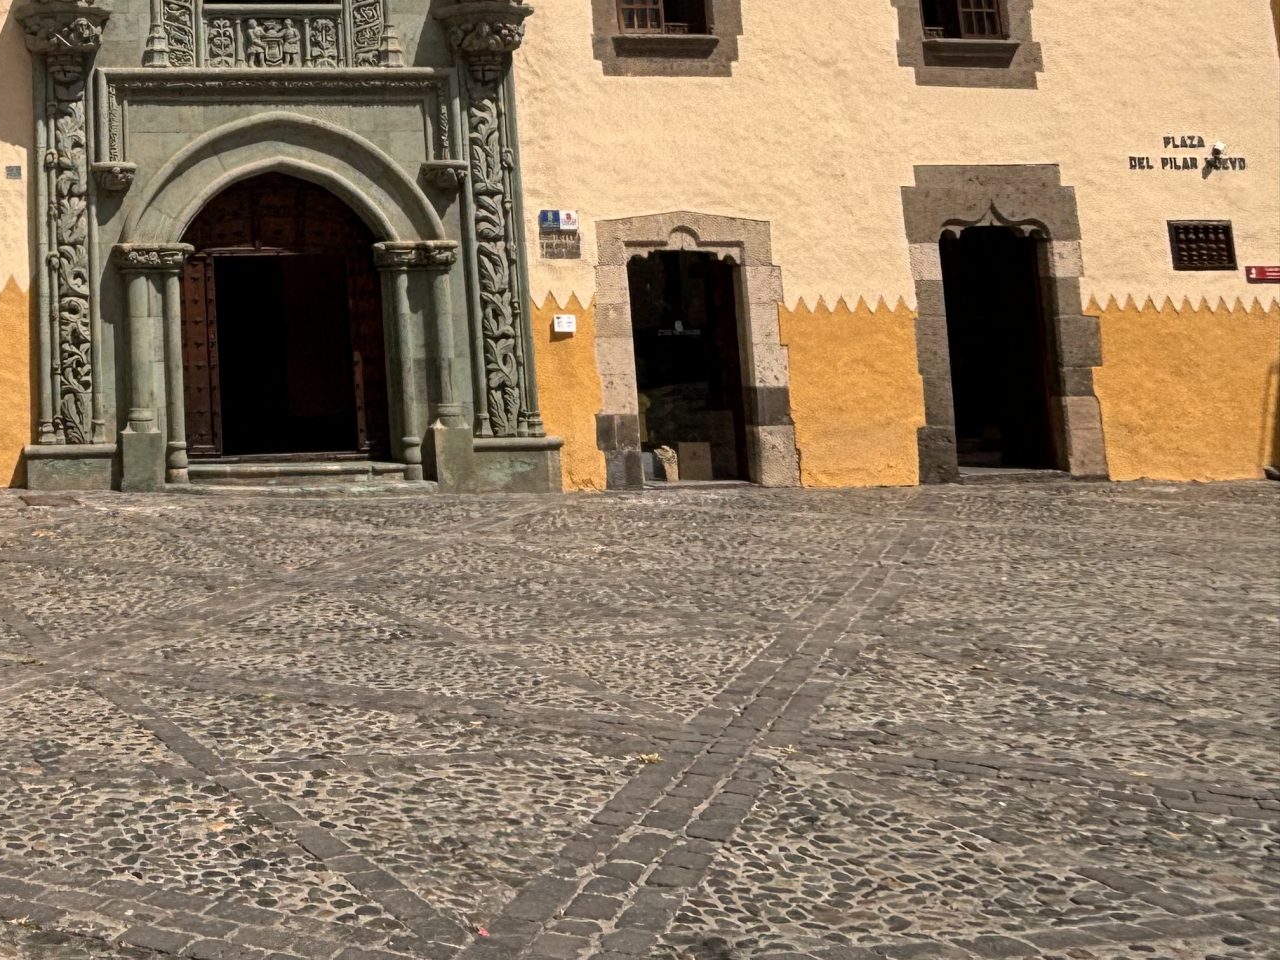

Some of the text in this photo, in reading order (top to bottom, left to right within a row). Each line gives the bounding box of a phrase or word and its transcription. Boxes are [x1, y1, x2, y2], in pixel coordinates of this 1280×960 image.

[1163, 135, 1205, 149] PLAZA
[1128, 156, 1154, 170] DEL
[1160, 157, 1198, 171] PILAR
